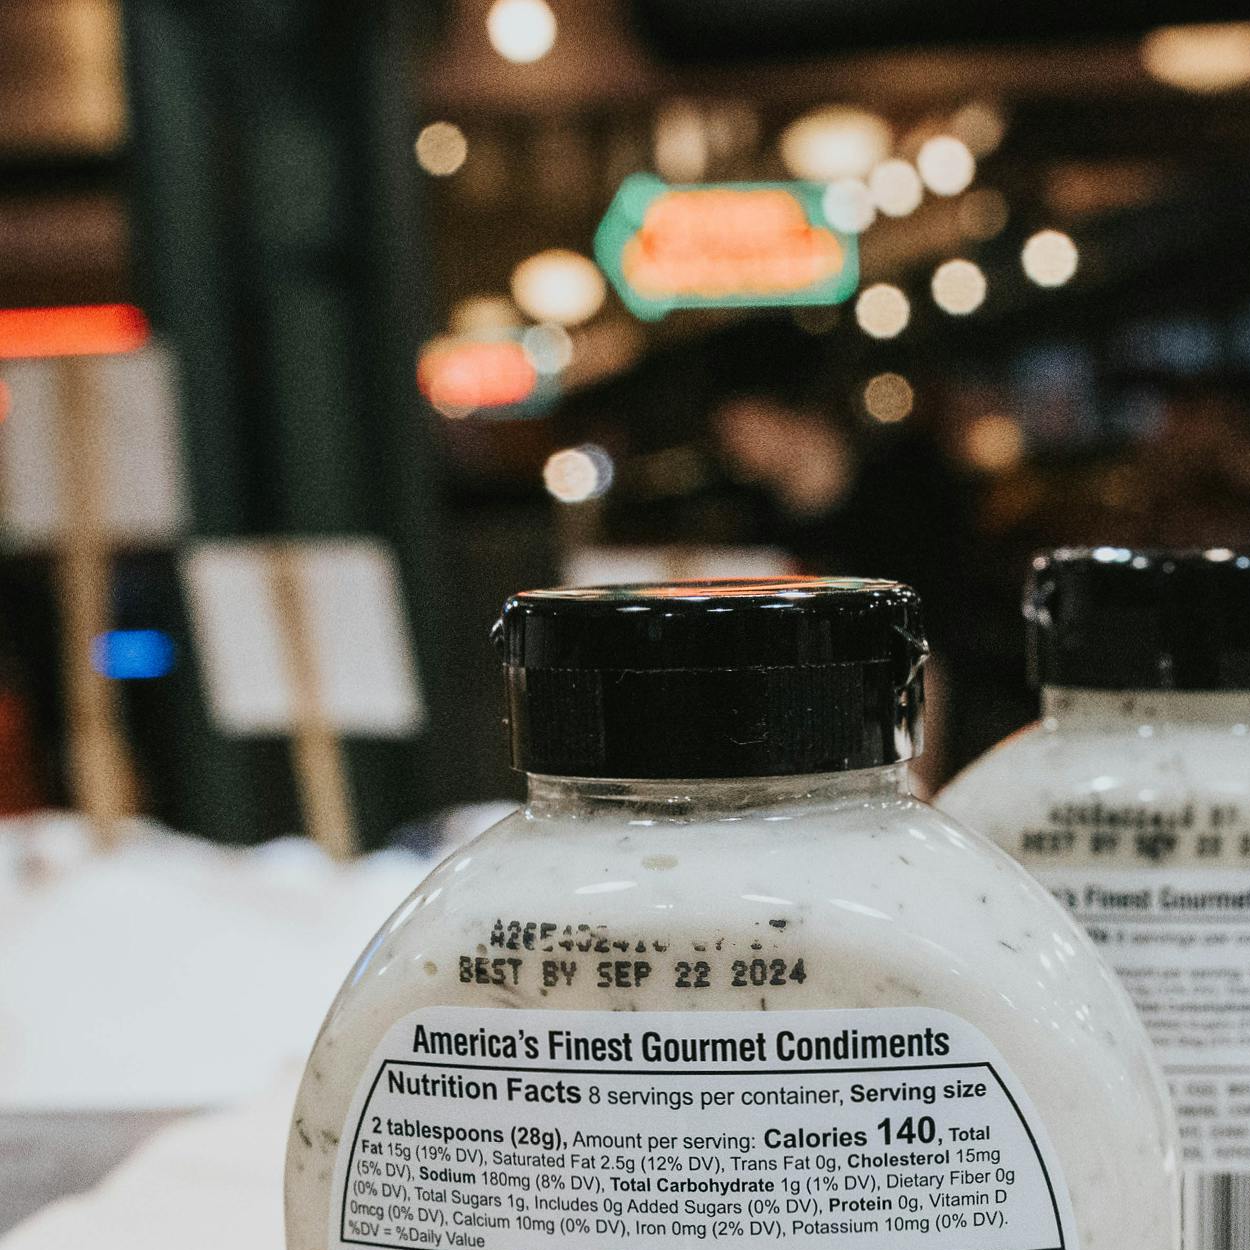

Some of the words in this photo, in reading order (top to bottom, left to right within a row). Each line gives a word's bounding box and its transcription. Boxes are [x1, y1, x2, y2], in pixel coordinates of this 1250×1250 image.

[459, 956, 523, 985] BEST
[542, 960, 577, 986] BY
[597, 961, 651, 988] SEP
[675, 961, 711, 988] 22
[731, 959, 807, 987] 2024
[412, 1024, 539, 1059] America's
[548, 1030, 633, 1062] Finest
[642, 1031, 767, 1062] Gourmet
[776, 1028, 950, 1061] Condiments
[388, 1070, 497, 1100] Nutrition
[507, 1077, 582, 1104] Facts
[589, 1086, 601, 1104] 8
[608, 1087, 694, 1110] servings
[701, 1091, 735, 1110] per
[741, 1086, 843, 1106] container,
[850, 1082, 936, 1104] Serving
[943, 1080, 987, 1099] size
[372, 1117, 382, 1134] 2
[387, 1119, 504, 1144] tablespoons
[511, 1126, 567, 1151] (28g),
[572, 1131, 642, 1149] Amount
[648, 1136, 678, 1153] per
[683, 1133, 755, 1153] serving:
[764, 1127, 867, 1149] Calories
[877, 1116, 942, 1146] 140,
[948, 1125, 990, 1142] Total
[349, 1220, 379, 1236] %DV
[396, 1226, 442, 1247] %Daily
[446, 1231, 485, 1248] Value
